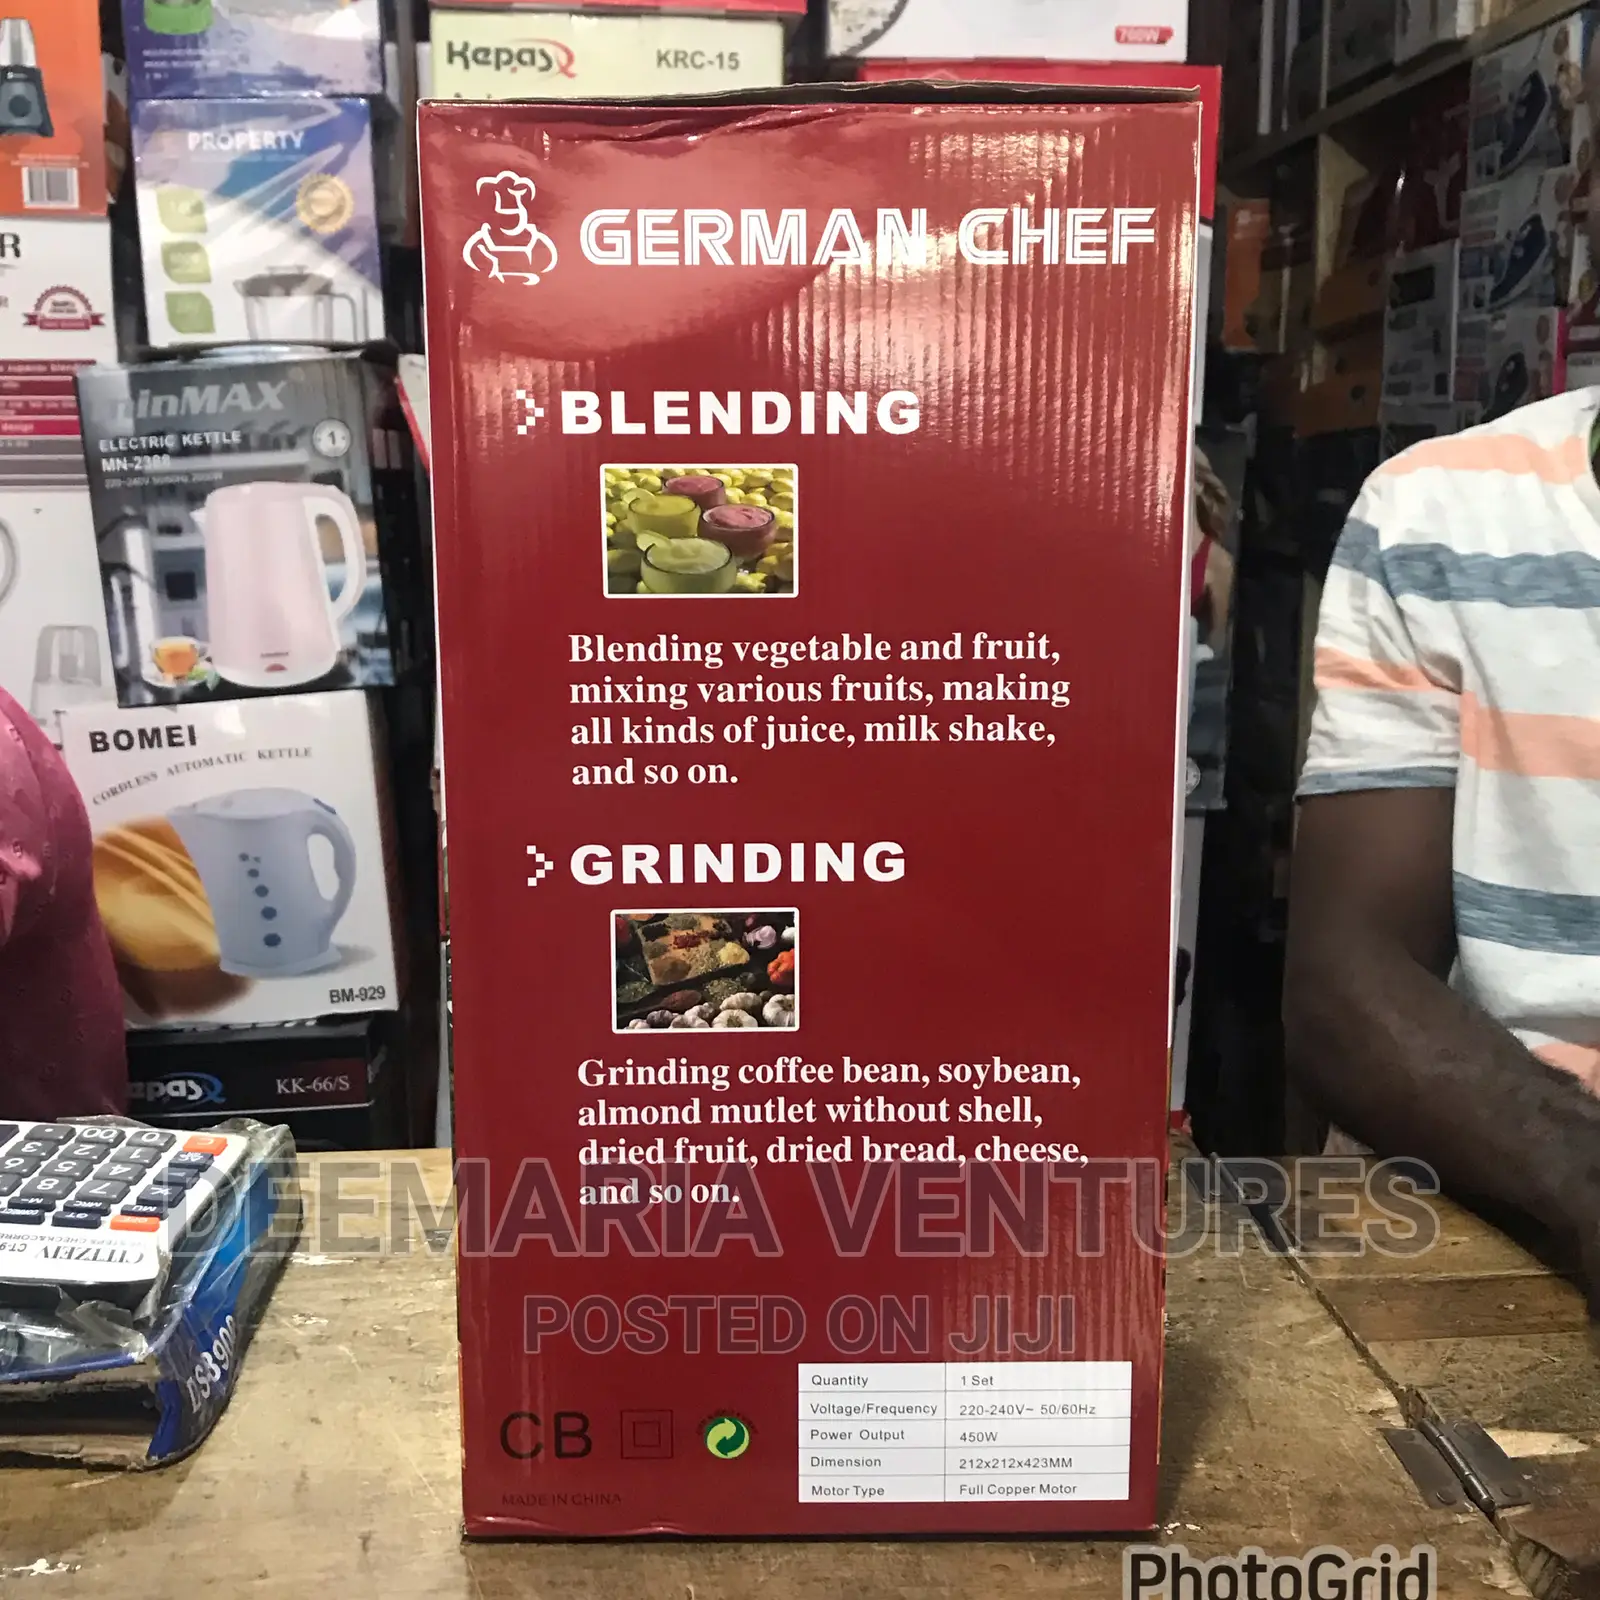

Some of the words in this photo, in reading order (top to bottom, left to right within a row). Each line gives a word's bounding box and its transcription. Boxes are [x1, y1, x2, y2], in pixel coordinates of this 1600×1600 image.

[655, 48, 741, 71] KRC-15
[187, 130, 305, 151] PROPERTY
[579, 207, 927, 266] GERMAN
[957, 207, 1157, 265] CHEF
[108, 379, 287, 428] inMAX
[561, 389, 922, 436] BLENDING
[99, 434, 176, 453] ELECTRIC
[182, 430, 242, 447] KETTLE
[568, 633, 724, 669] Blending
[732, 633, 891, 669] vegetable
[900, 632, 963, 661] and
[972, 631, 1061, 666] fruit,
[569, 675, 688, 710] mixing
[696, 674, 822, 703] various
[830, 673, 934, 707] fruits,
[942, 672, 1071, 708] making
[89, 724, 198, 753] BOMEI
[571, 717, 613, 745] all
[622, 716, 715, 744] kinds
[723, 715, 757, 744] of
[760, 715, 856, 750] juice,
[864, 714, 940, 742] milk
[948, 714, 1056, 747] shake,
[92, 771, 159, 806] CORDLESS
[166, 750, 248, 778] AUTOMATIC
[257, 746, 313, 761] KETTLE
[572, 757, 635, 785] and
[644, 764, 679, 785] so
[687, 764, 738, 784] on.
[570, 841, 906, 886] GRINDING
[328, 985, 386, 1004] BM-929
[577, 1057, 730, 1091] Grinding
[738, 1056, 834, 1084] coffee
[842, 1056, 931, 1089] bean,
[938, 1056, 1081, 1090] soybean,
[275, 1074, 350, 1095] KK-66/S
[578, 1097, 702, 1125] almond
[710, 1096, 817, 1124] mutlet
[825, 1095, 951, 1123] without
[958, 1095, 1043, 1129] shell,
[21, 1141, 42, 1150] 3
[73, 1144, 96, 1156] 2
[578, 1137, 665, 1166] dried
[674, 1136, 758, 1169] fruit,
[766, 1135, 853, 1164] dried
[861, 1135, 966, 1168] bread,
[974, 1135, 1089, 1167] cheese,
[4, 1158, 25, 1169] 6
[54, 1161, 77, 1172] 5
[108, 1164, 132, 1176] 4
[36, 1178, 60, 1190] 8
[89, 1182, 112, 1195] 7
[579, 1178, 640, 1206] and
[649, 1184, 683, 1205] so
[690, 1184, 740, 1204] on.
[811, 1374, 869, 1389] Quantity
[971, 1375, 994, 1386] Set
[810, 1403, 938, 1417] Voltage/Frequency
[1040, 1403, 1096, 1416] 50/60Hz
[500, 1410, 592, 1460] CB
[810, 1429, 853, 1441] Power
[859, 1429, 905, 1444] Output
[959, 1431, 998, 1443] 450W
[810, 1456, 882, 1468] Dimension
[958, 1457, 1073, 1470] 212x212x423MM
[501, 1493, 548, 1506] MADE
[552, 1493, 568, 1506] IN
[571, 1492, 622, 1506] CHINA
[811, 1484, 850, 1496] Motor
[852, 1484, 885, 1498] Type
[959, 1484, 984, 1496] Full
[987, 1483, 1036, 1498] Copper
[1039, 1482, 1078, 1495] Motor
